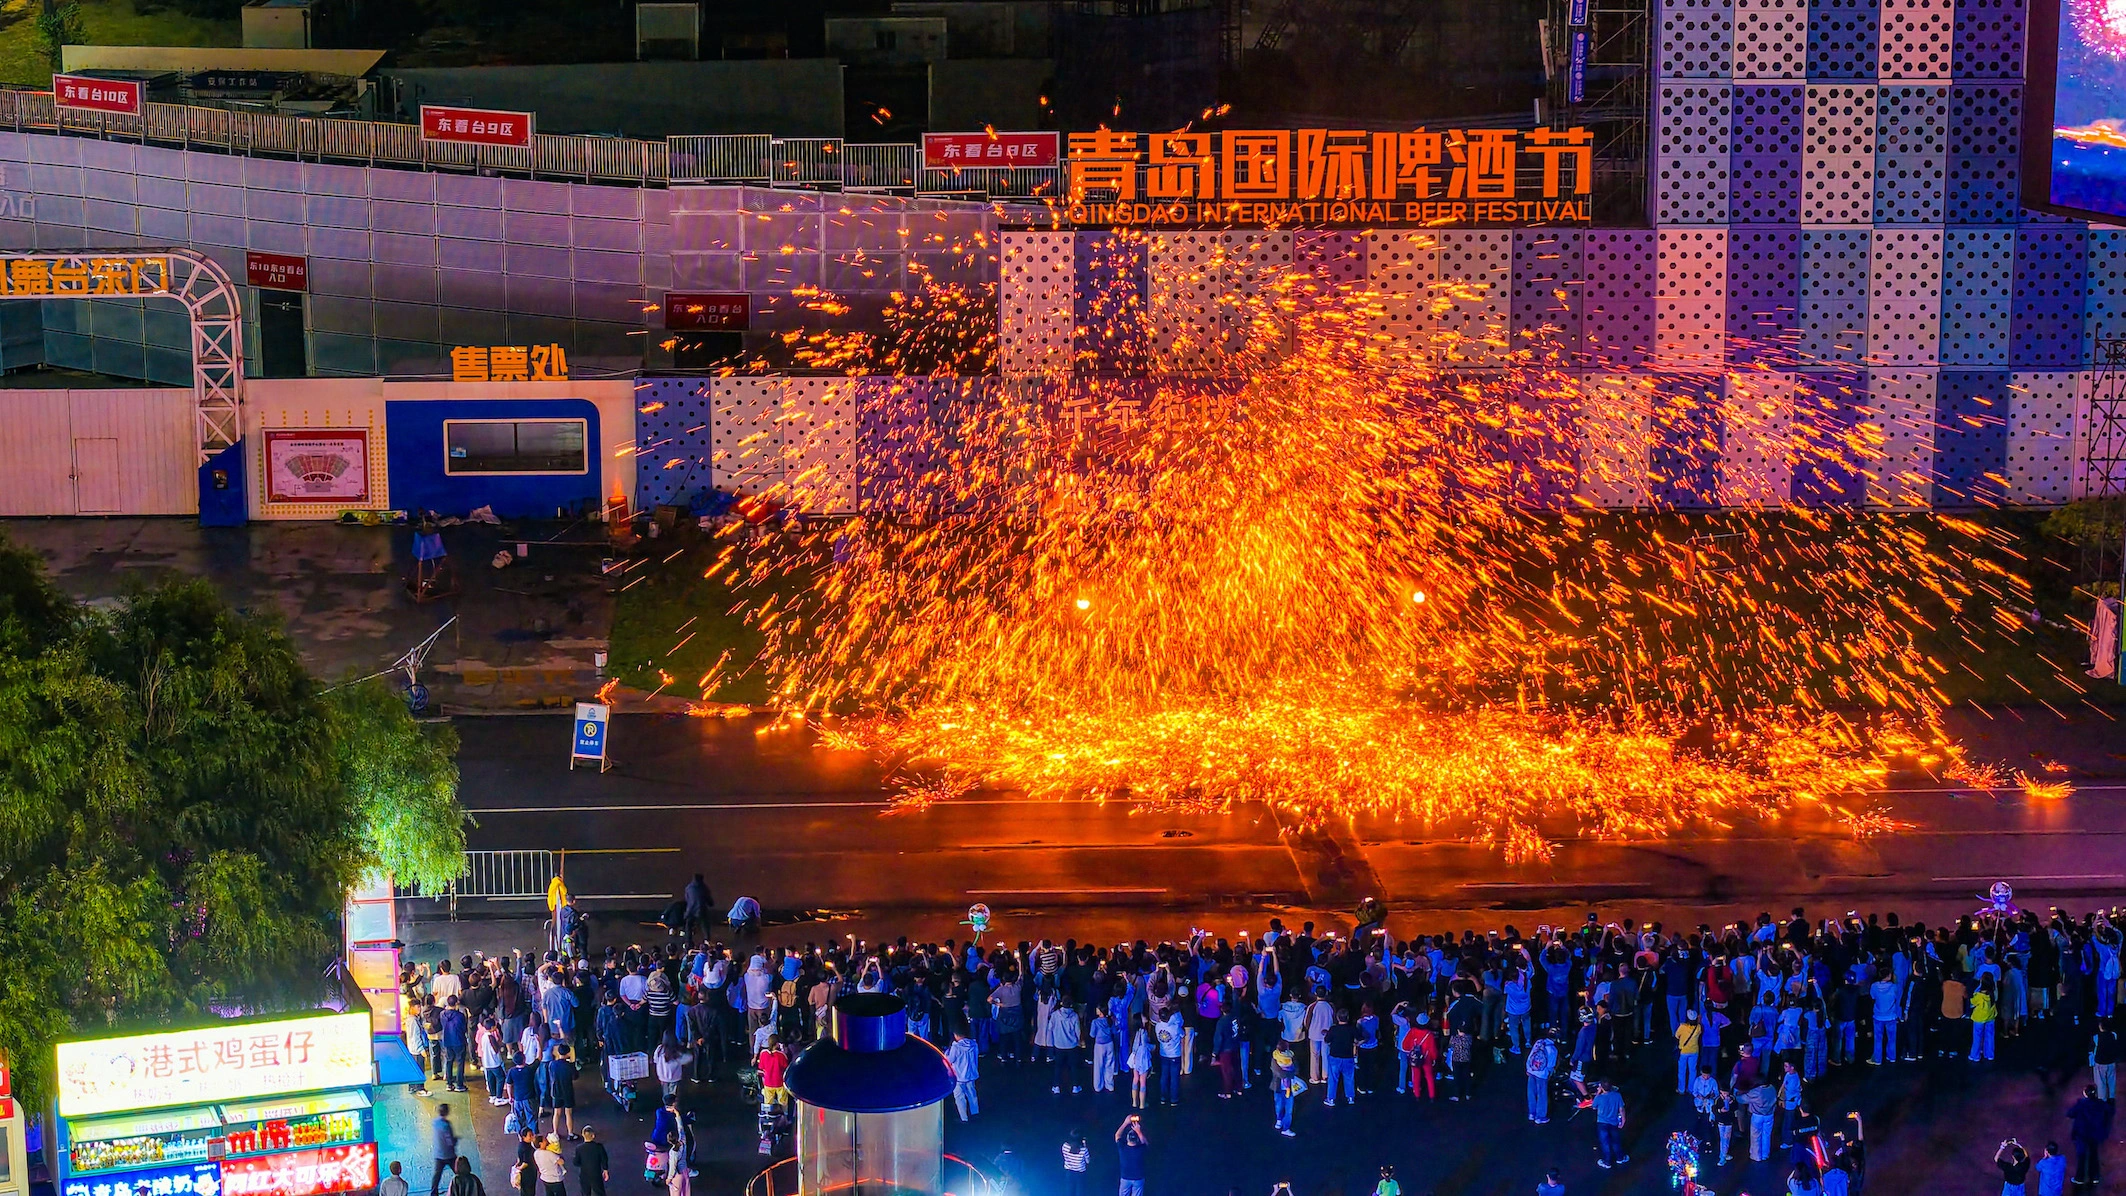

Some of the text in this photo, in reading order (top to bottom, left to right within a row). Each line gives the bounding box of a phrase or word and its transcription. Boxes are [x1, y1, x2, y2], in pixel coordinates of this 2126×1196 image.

[64, 85, 129, 105] 东看台10区
[437, 117, 514, 136] 东看台9区
[943, 143, 1039, 158] 东看台8区
[1067, 126, 1595, 201] 青岛国际啤酒节
[1068, 200, 1592, 225] QINGDAO INTERNATIONAL BEER FESTIVAL
[0, 257, 169, 296] 舞台东门
[249, 261, 304, 276] 东10东9看台
[268, 273, 286, 283] 入口
[696, 314, 719, 324] 入口
[450, 343, 568, 382] 售票处
[142, 1030, 316, 1080] 港式鸡蛋仔
[224, 1161, 342, 1193] 网红大可乐
